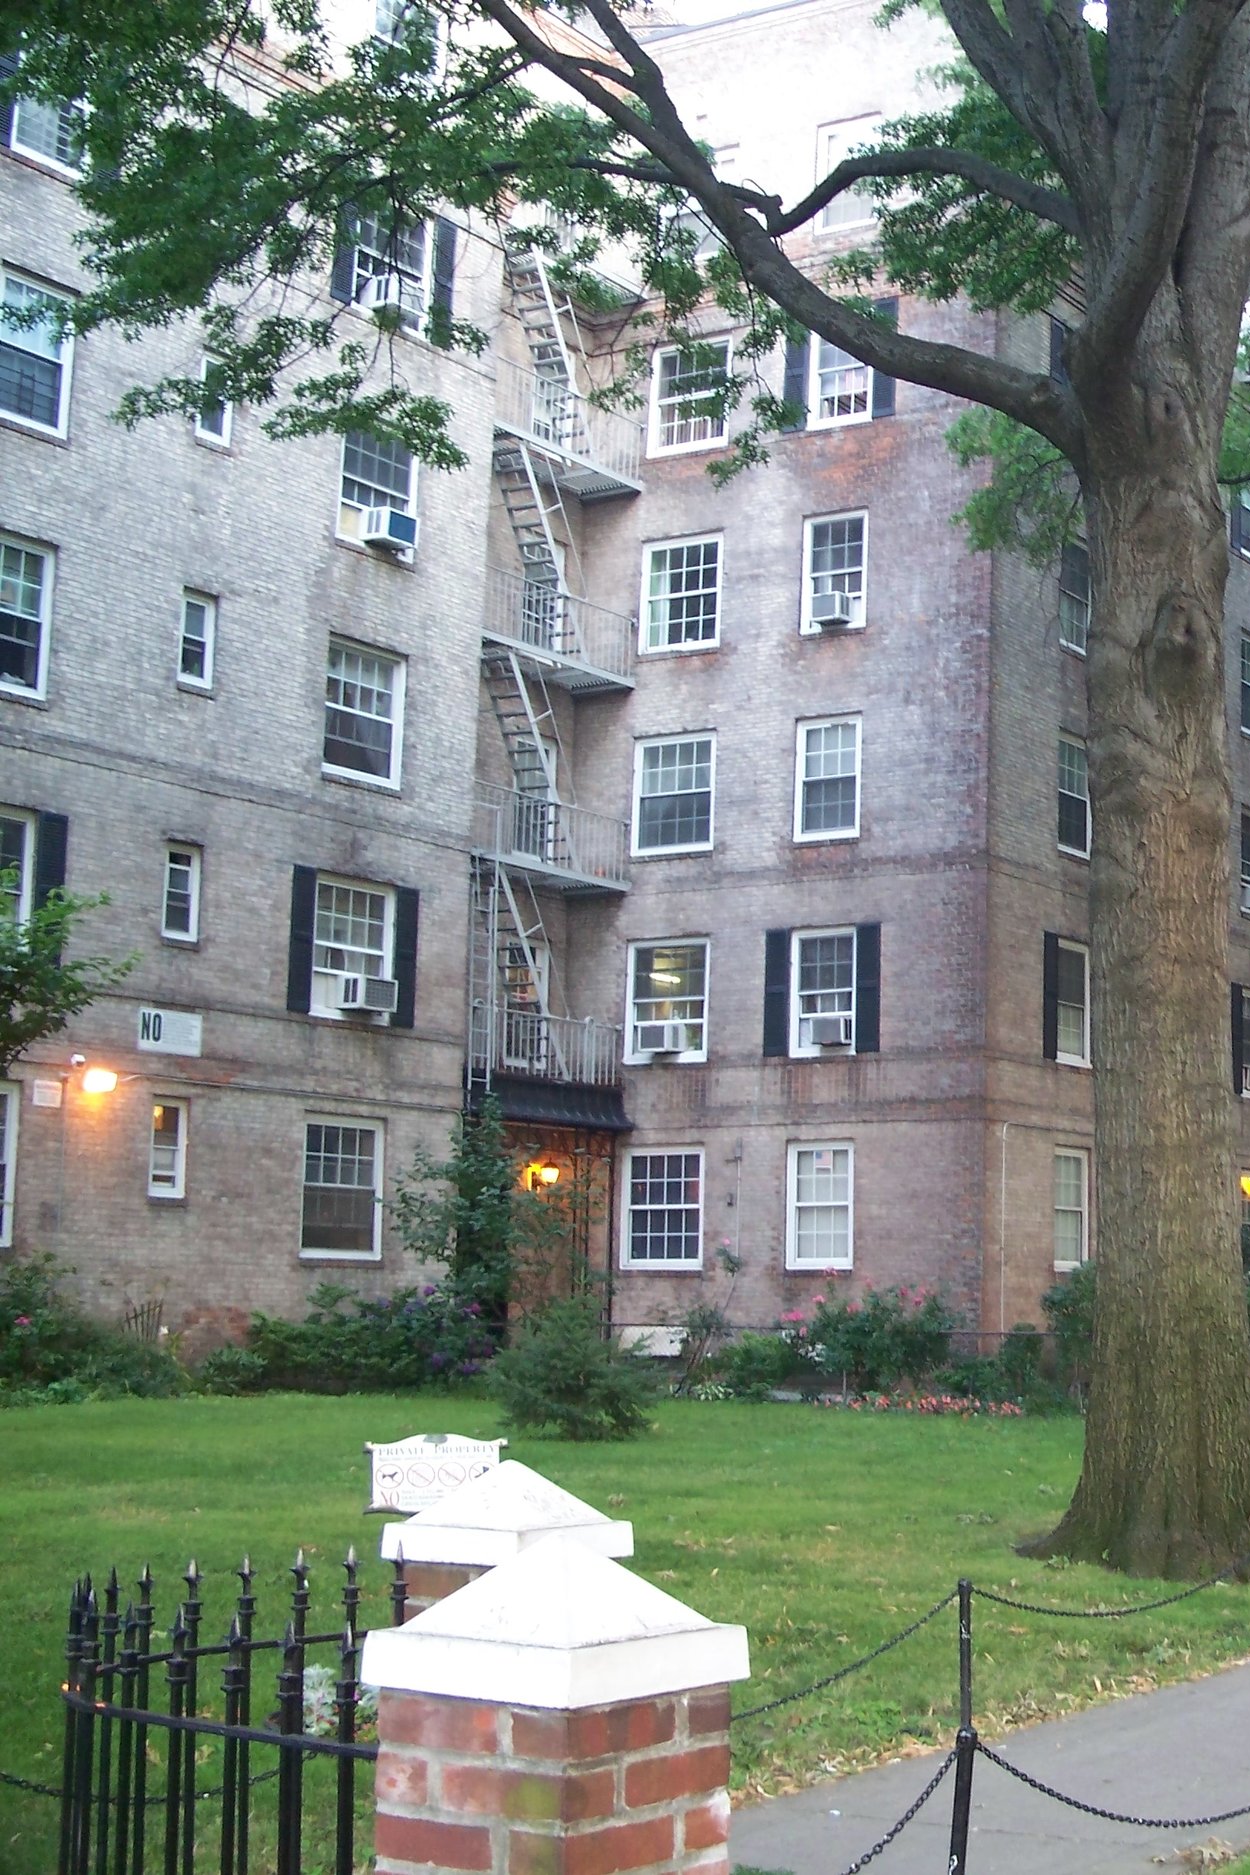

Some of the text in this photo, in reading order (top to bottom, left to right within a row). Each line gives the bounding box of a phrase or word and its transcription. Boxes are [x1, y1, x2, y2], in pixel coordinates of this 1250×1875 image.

[141, 1011, 162, 1042] NO
[378, 1445, 495, 1456] PRIVATE PROPERTY
[378, 1490, 400, 1506] NO
